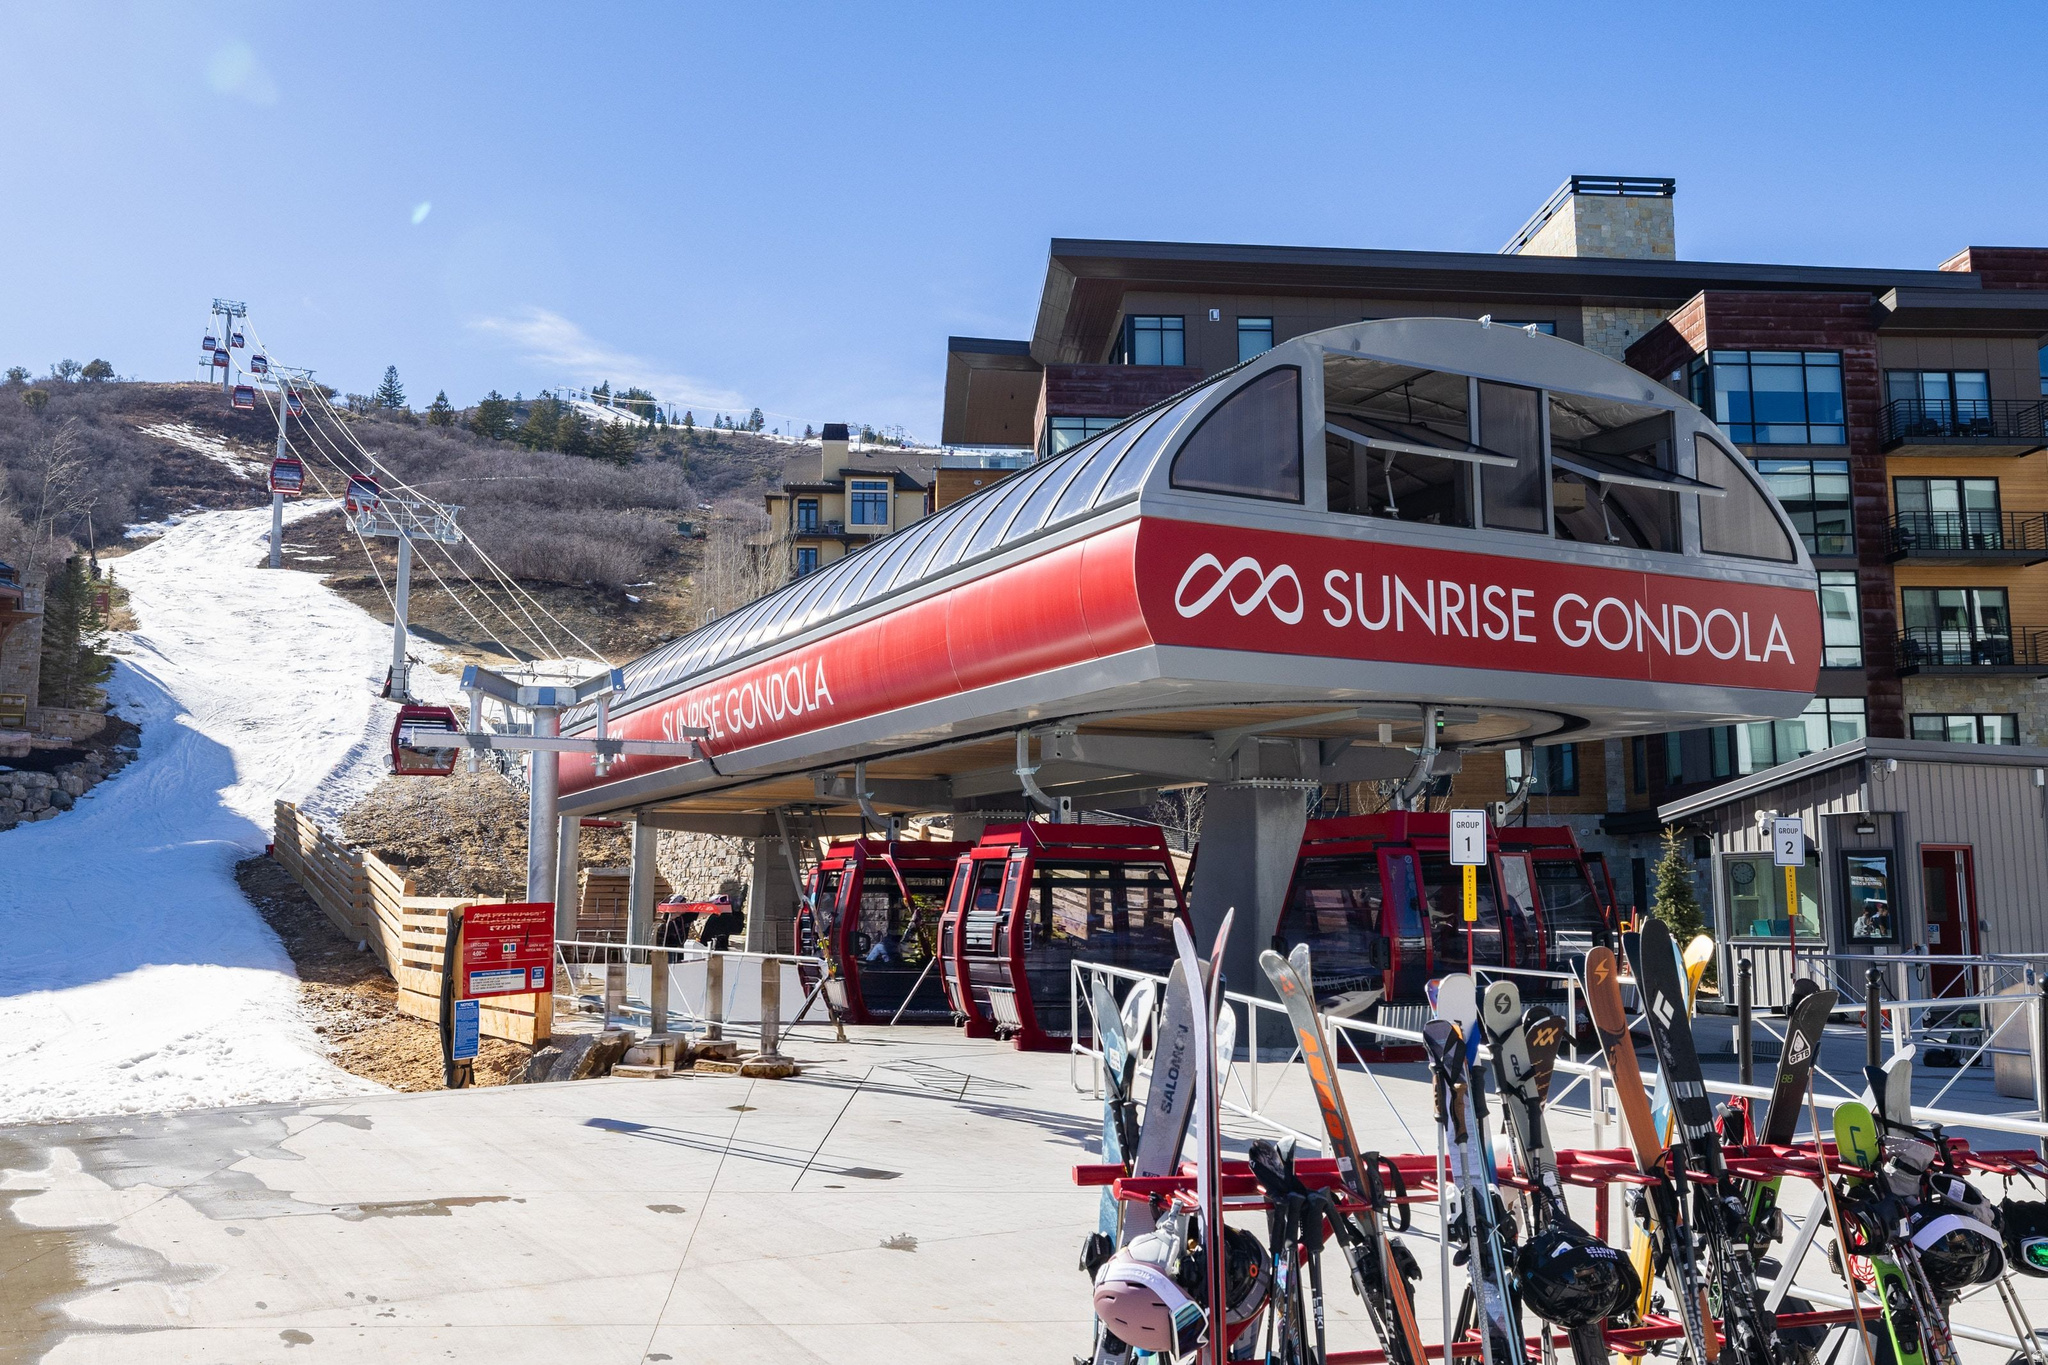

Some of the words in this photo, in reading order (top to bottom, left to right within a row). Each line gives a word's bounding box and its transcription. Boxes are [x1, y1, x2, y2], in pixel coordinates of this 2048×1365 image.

[1322, 568, 1537, 644] SUNRISE
[1552, 592, 1796, 665] GONDOLA
[661, 694, 725, 745] SUNRISE
[725, 656, 834, 734] GONDOLA
[1456, 821, 1480, 829] GROUP
[1778, 827, 1799, 835] GROUP
[1464, 836, 1471, 852] 1
[1785, 840, 1794, 855] 2
[1345, 977, 1372, 991] CITY
[1790, 1048, 1810, 1064] GFTB
[1161, 1024, 1189, 1114] SALOMON
[1584, 1246, 1616, 1256] MASTER
[1316, 1296, 1324, 1329] LEKI
